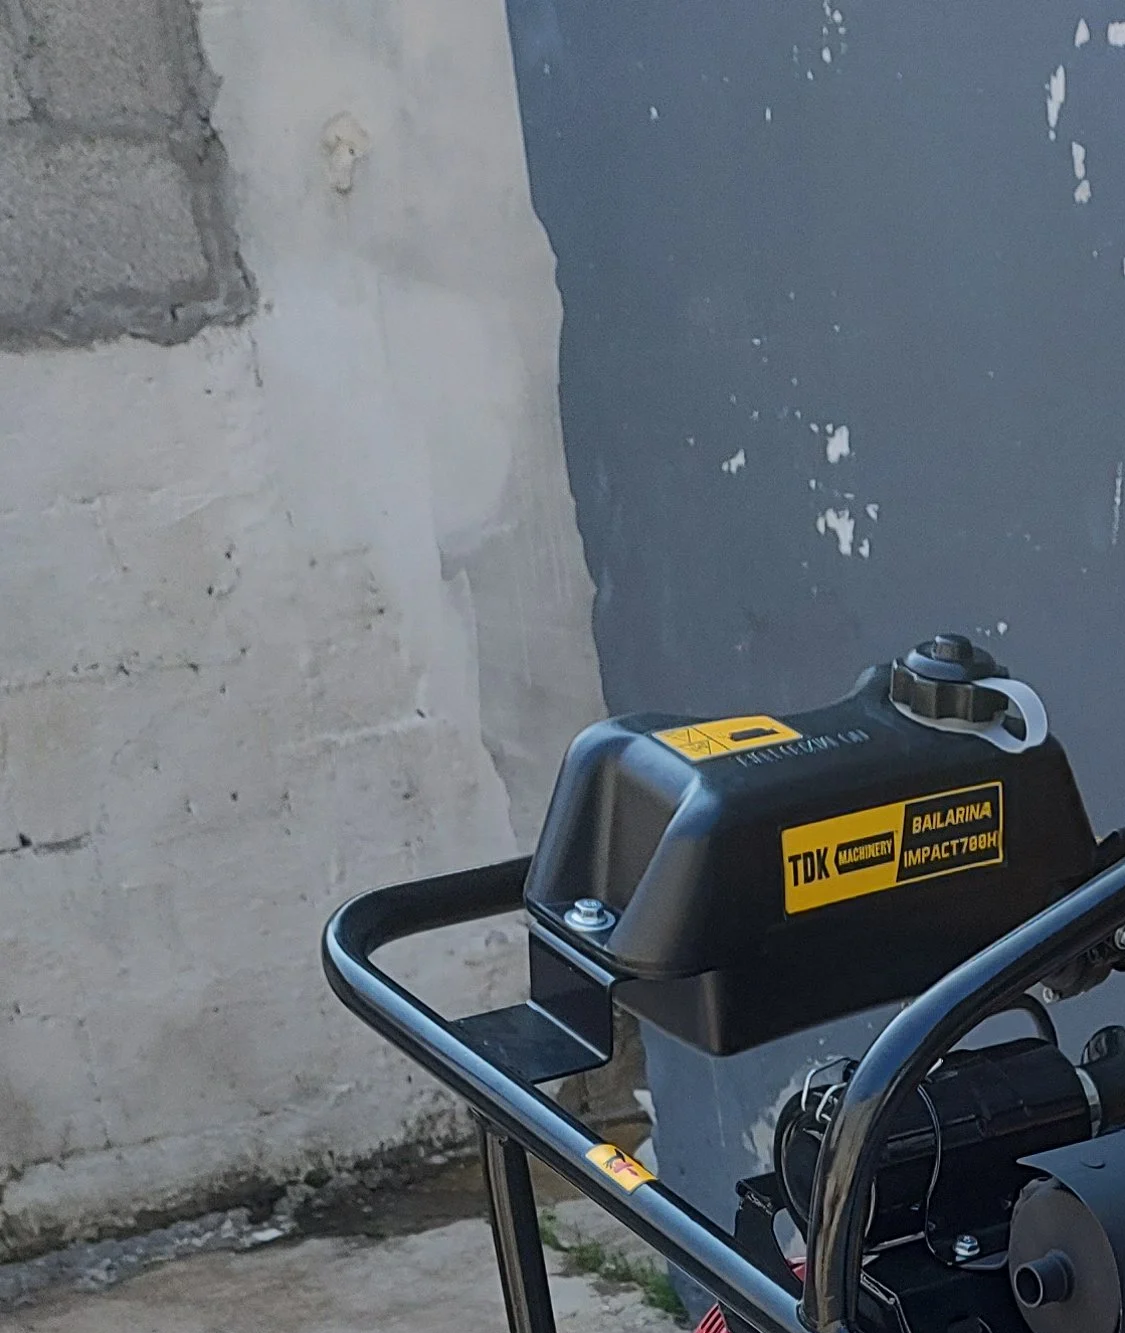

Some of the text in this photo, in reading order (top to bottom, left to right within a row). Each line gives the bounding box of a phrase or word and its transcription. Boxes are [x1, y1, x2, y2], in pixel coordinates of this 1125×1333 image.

[912, 801, 992, 834] BAILARINA
[788, 839, 893, 887] TDK MACHINERY
[904, 831, 999, 868] IMPACT700H
